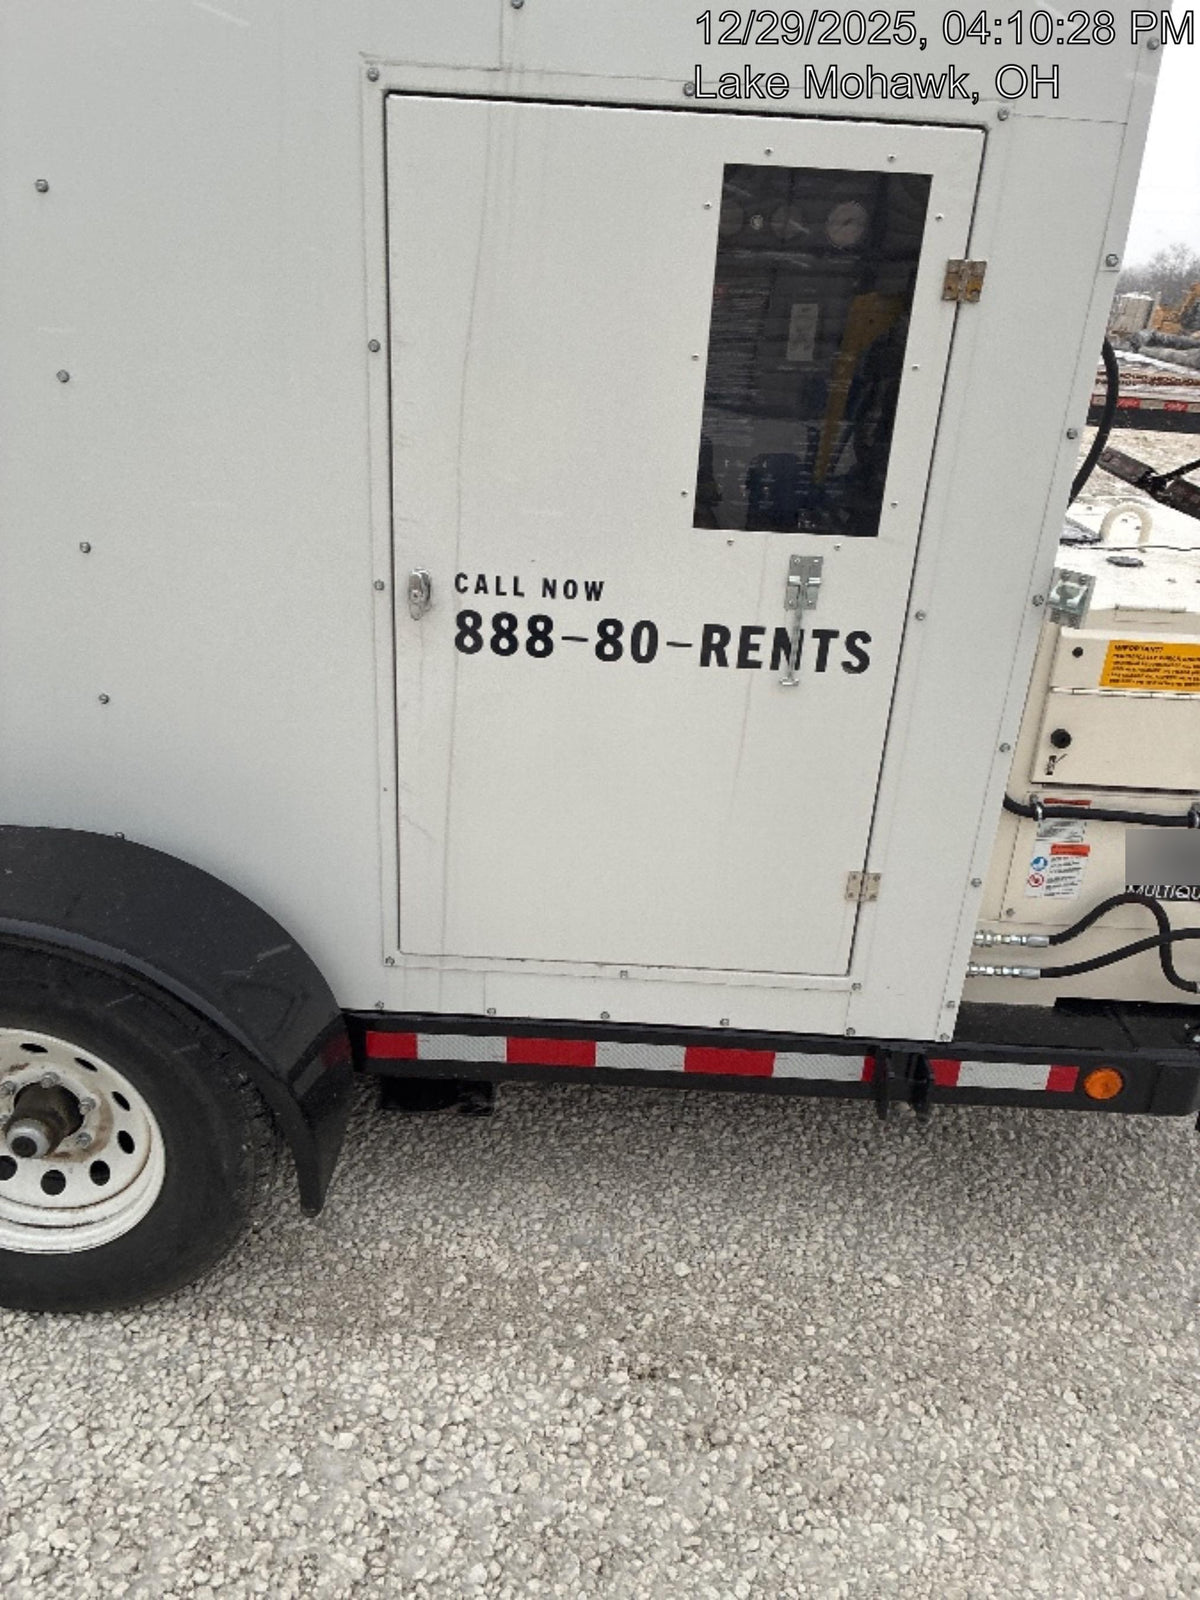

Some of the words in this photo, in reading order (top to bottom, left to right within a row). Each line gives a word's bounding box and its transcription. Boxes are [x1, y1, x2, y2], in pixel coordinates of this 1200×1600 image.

[454, 572, 525, 598] CALL
[541, 577, 605, 602] NOW
[454, 609, 872, 675] 888-80-RENTS
